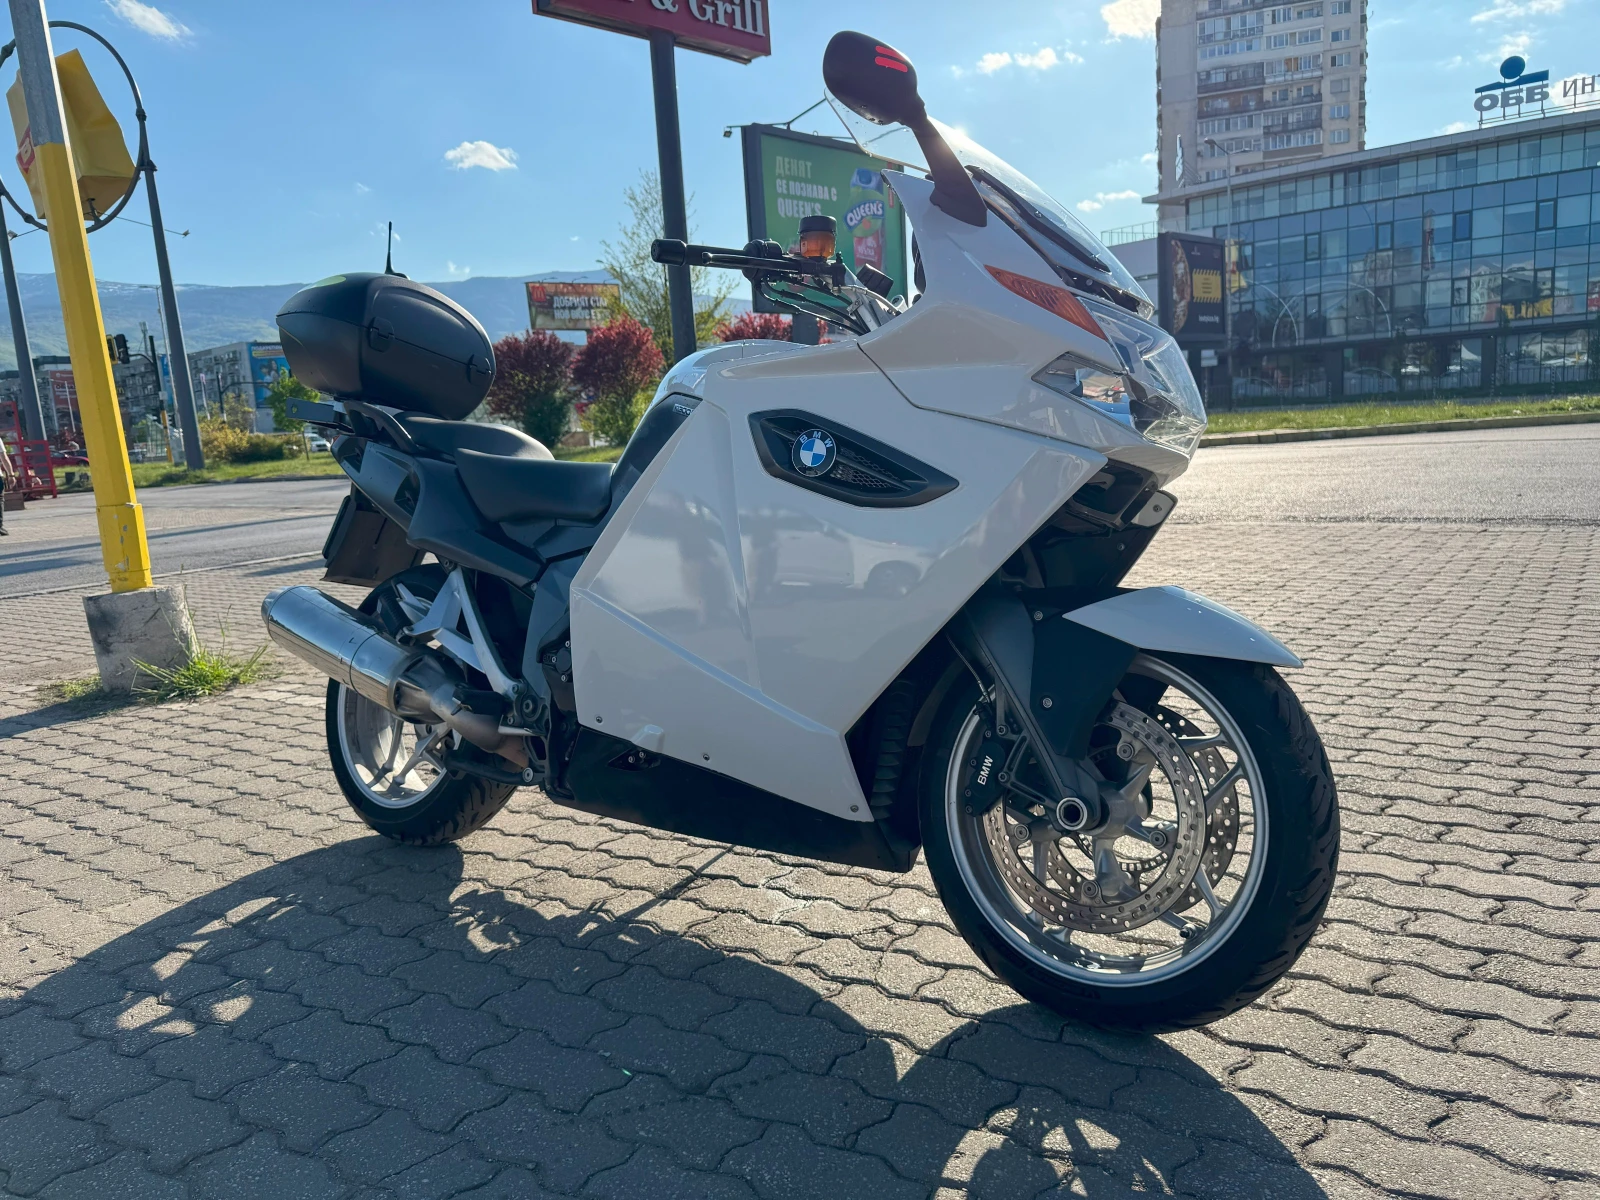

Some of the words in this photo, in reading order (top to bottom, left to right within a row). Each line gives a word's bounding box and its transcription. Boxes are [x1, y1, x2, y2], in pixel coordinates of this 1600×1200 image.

[689, 0, 766, 37] Grill
[1473, 83, 1550, 112] ОББ
[1563, 75, 1600, 98] ИН
[775, 156, 812, 179] ДЕНЯТ
[776, 178, 787, 194] СЕ
[789, 180, 829, 200] ПОЗНАВА
[831, 186, 837, 201] С
[777, 198, 821, 218] QUEEN'S
[846, 201, 882, 226] QUEEN'S
[799, 430, 834, 449] BMW
[977, 755, 993, 785] BMW
